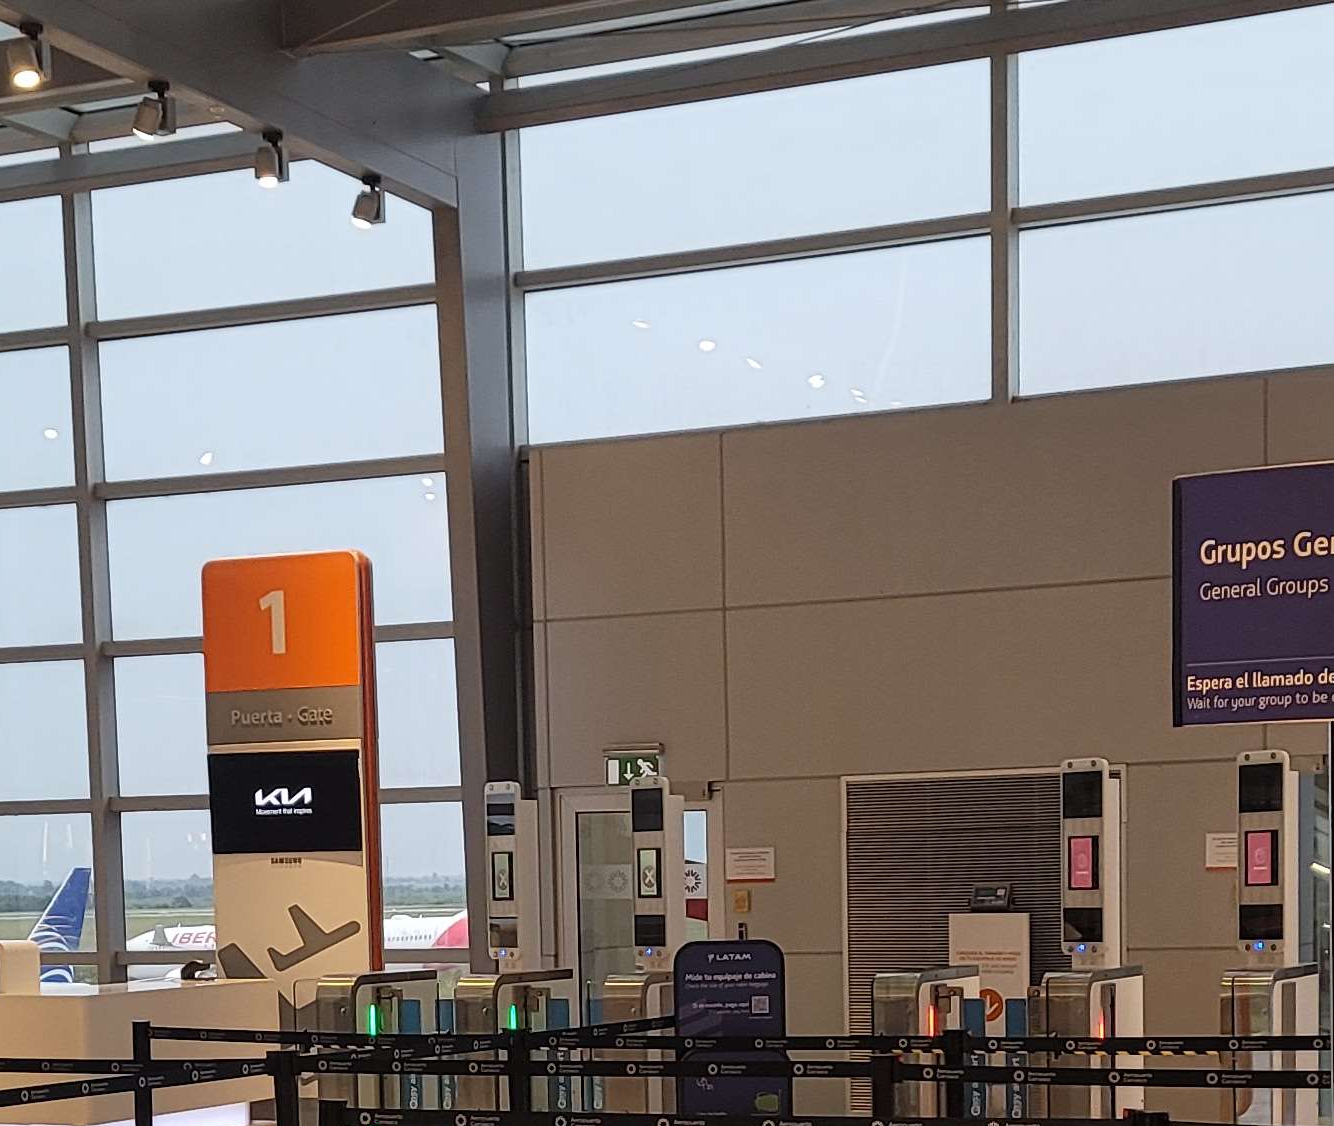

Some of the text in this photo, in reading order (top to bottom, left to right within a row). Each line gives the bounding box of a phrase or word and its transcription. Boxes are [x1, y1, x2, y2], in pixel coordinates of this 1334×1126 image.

[1199, 539, 1285, 569] Grupos
[1199, 575, 1329, 601] General Groups
[258, 590, 287, 655] 1
[1187, 676, 1233, 695] Espera
[1236, 674, 1250, 689] el
[1252, 670, 1314, 688] llamado
[1187, 697, 1210, 711] Wait
[1213, 695, 1229, 709] for
[1231, 695, 1257, 711] your
[1258, 694, 1292, 710] group
[1295, 692, 1309, 706] to
[1312, 691, 1328, 705] be
[231, 705, 333, 727] Puerta Gate
[716, 953, 752, 961] LATAM
